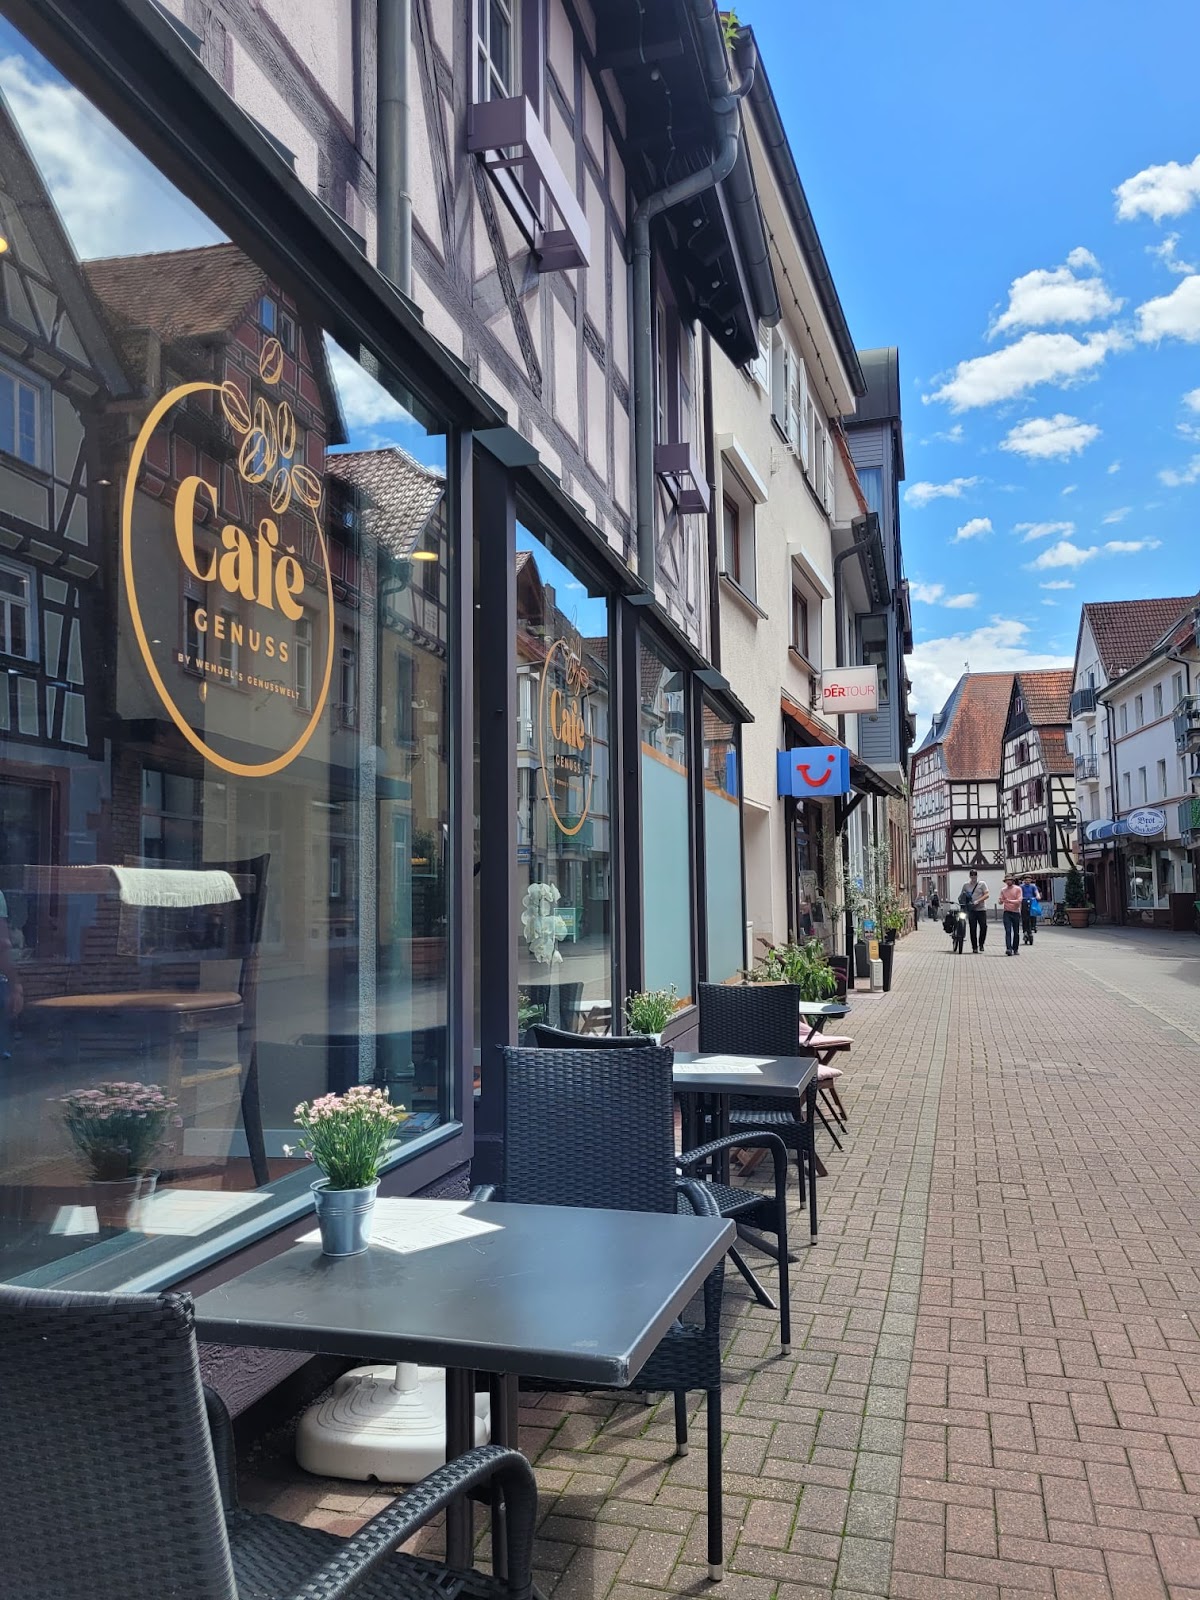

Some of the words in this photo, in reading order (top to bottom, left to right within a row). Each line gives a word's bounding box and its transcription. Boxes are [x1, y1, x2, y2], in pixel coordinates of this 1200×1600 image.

[174, 475, 305, 621] Café
[194, 608, 289, 663] GENUSS
[177, 652, 191, 665] BY
[195, 658, 244, 682] WENDEL'S
[247, 675, 300, 700] GENUSSWELT
[555, 753, 581, 775] GENUSS
[1137, 816, 1155, 825] Brot
